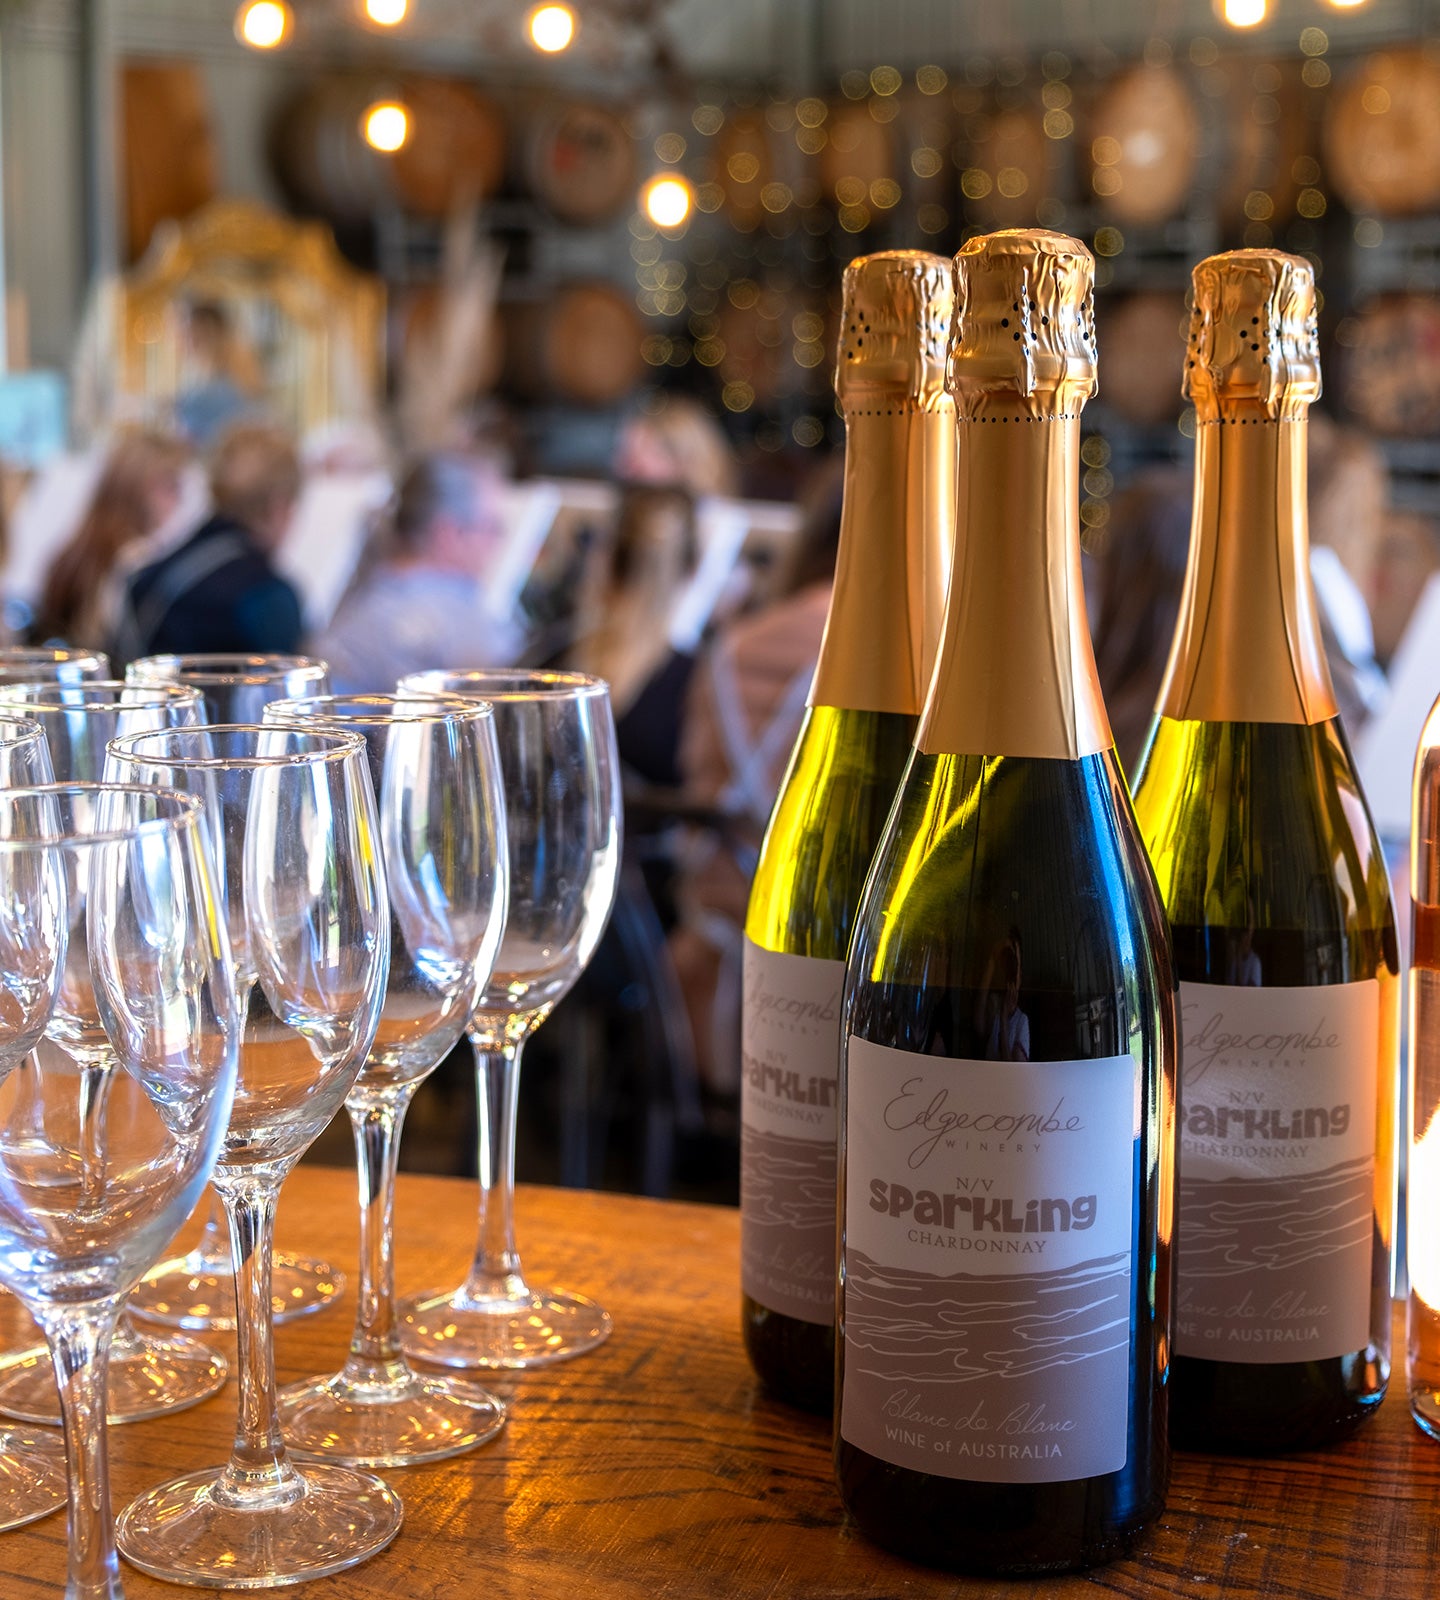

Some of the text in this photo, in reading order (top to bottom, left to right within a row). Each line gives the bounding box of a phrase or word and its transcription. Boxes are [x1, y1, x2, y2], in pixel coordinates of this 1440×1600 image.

[1219, 1058, 1306, 1068] WINERY
[1229, 1092, 1265, 1104] N/V
[883, 1077, 1085, 1169] Edgecombe
[945, 1139, 1041, 1153] WINERY
[955, 1177, 995, 1192] N/V
[907, 1229, 1047, 1254] CHARDONNAY
[1177, 1287, 1220, 1317] lanc
[1204, 1327, 1222, 1339] of
[1228, 1327, 1320, 1342] AUSTRALIA
[882, 1388, 1078, 1435] Blanc de Blanc
[885, 1424, 1062, 1460] WINE of AUSTRALIA
